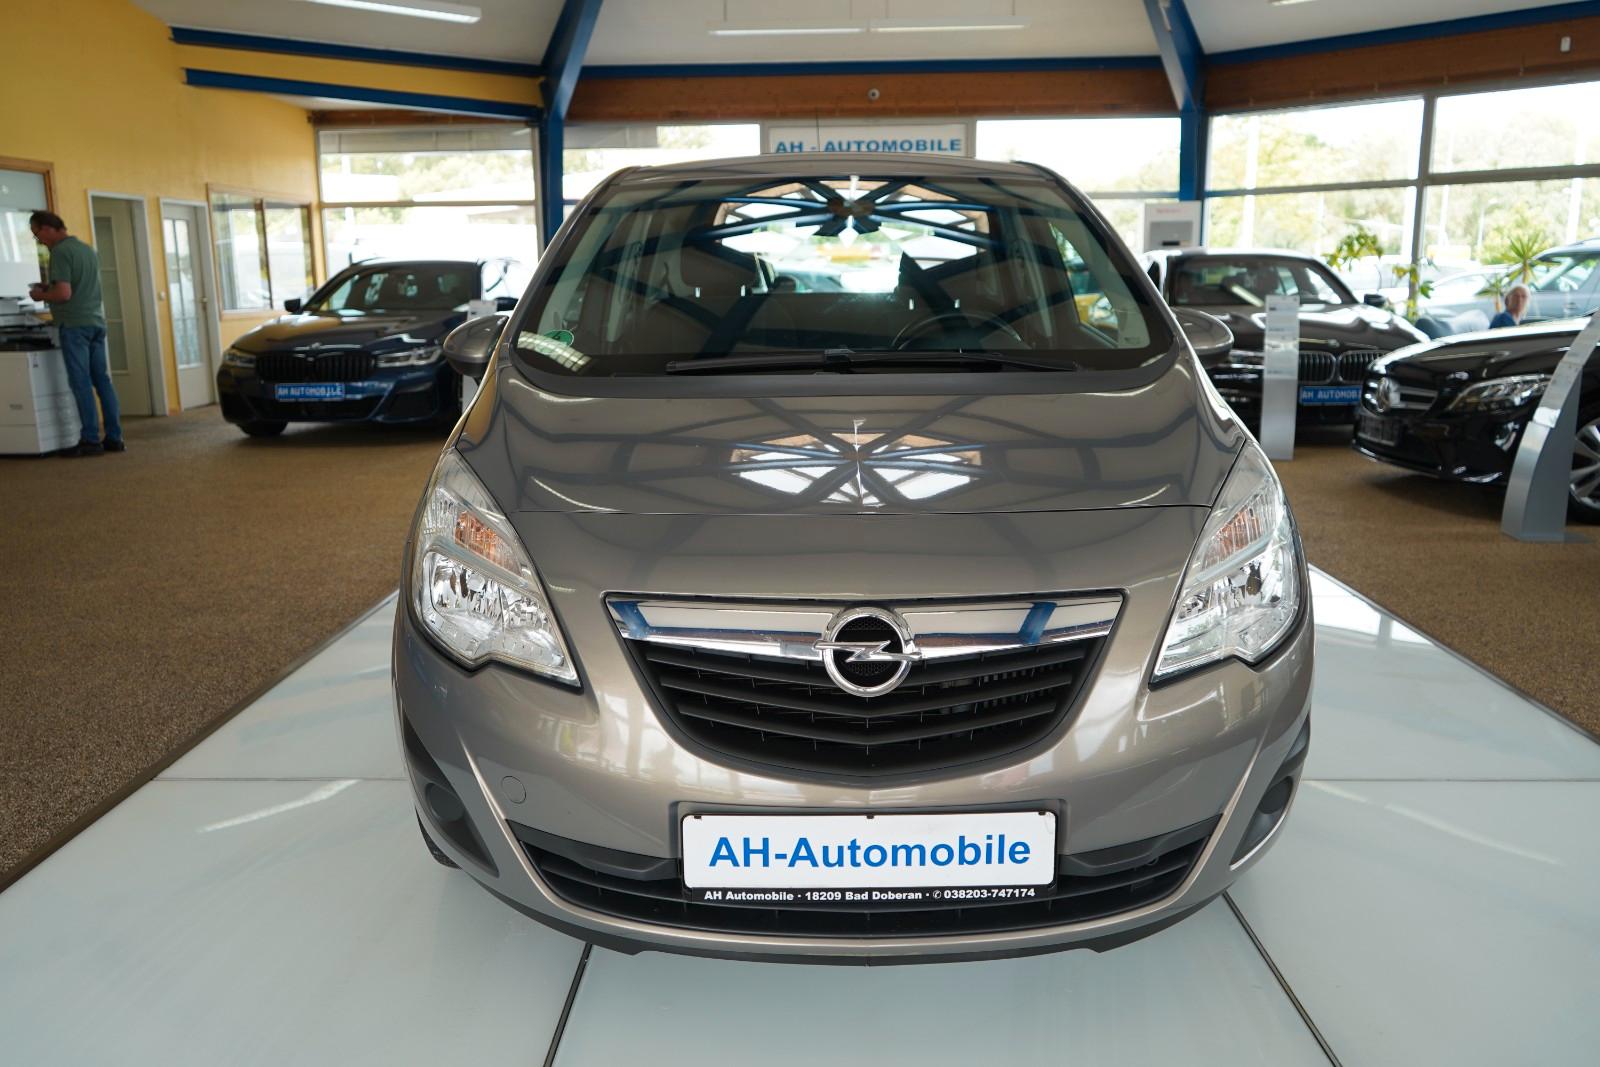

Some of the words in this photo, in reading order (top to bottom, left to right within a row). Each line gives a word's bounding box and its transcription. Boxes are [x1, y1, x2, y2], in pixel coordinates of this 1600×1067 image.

[776, 141, 804, 153] AH
[824, 139, 962, 153] AUTOMOBILE
[290, 385, 343, 397] AUTOMOBILE
[1302, 390, 1314, 400] AH
[708, 833, 1031, 868] AH-Automobile
[704, 890, 723, 901] AH
[726, 890, 794, 901] Automobile
[805, 891, 842, 901] 18209
[845, 891, 869, 901] Bad
[872, 890, 922, 900] Doberan
[943, 887, 1036, 899] 038203-747174
